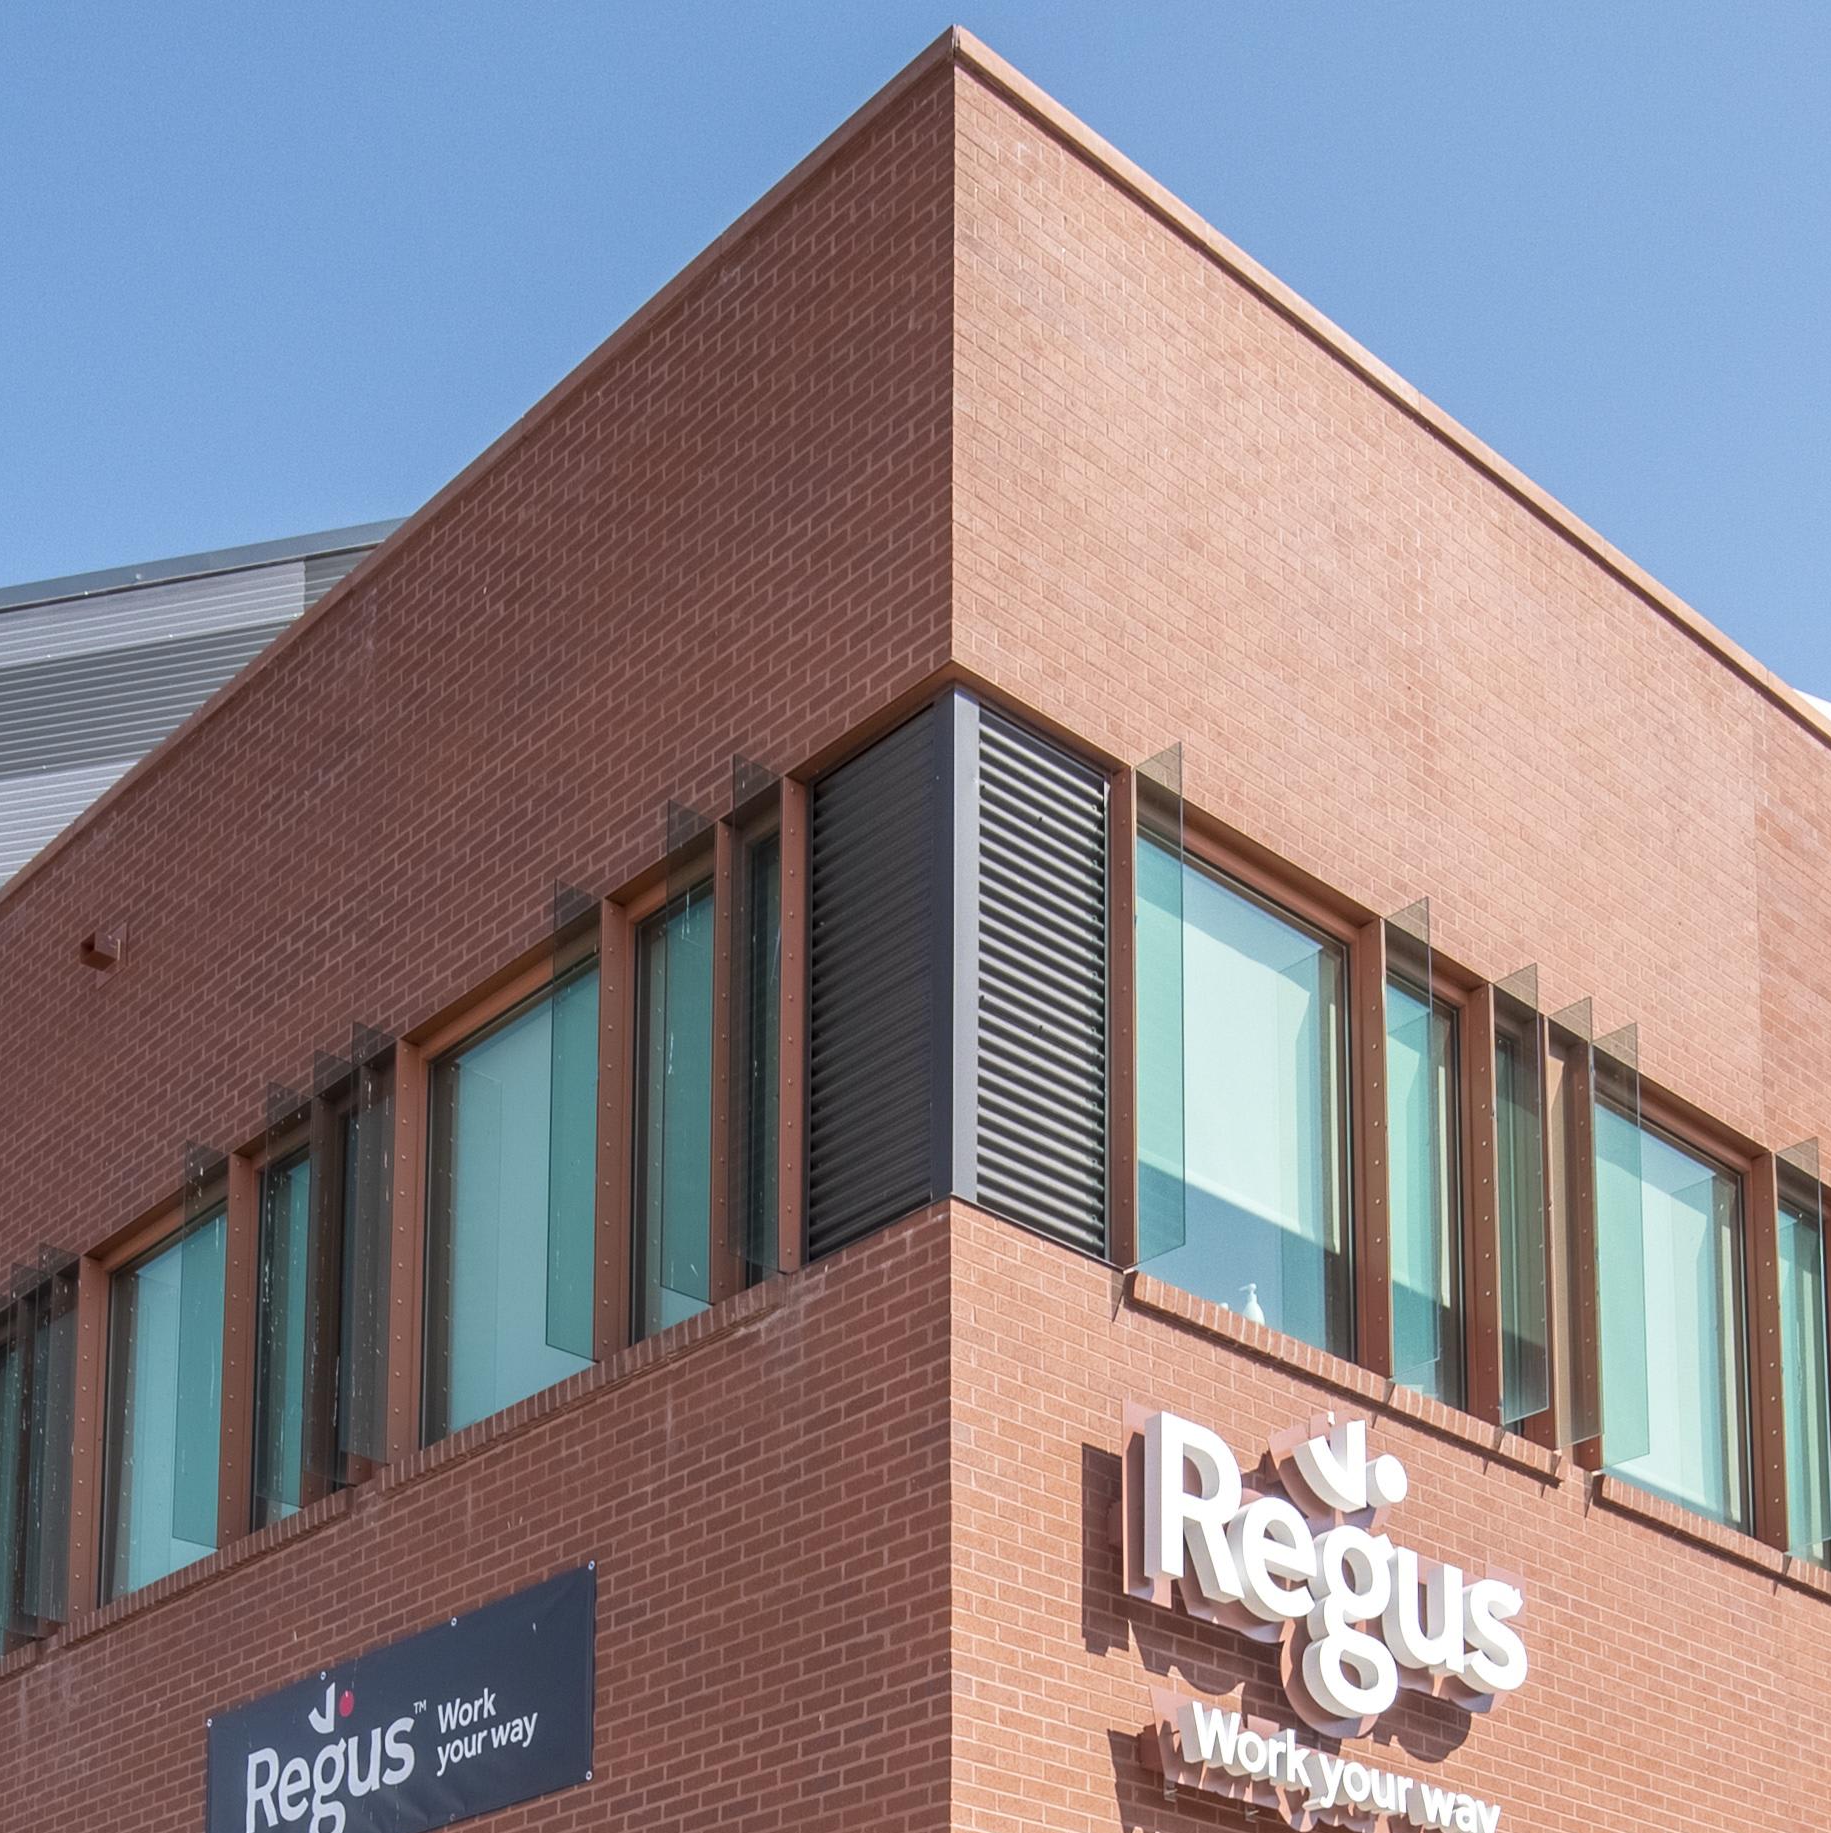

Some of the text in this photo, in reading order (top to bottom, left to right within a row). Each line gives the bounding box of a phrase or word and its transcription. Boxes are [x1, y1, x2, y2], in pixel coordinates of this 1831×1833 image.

[1144, 1410, 1528, 1718] Regus
[436, 1712, 538, 1776] your way
[437, 1687, 497, 1734] Work
[1178, 1700, 1312, 1789] Work
[1308, 1752, 1414, 1813] your
